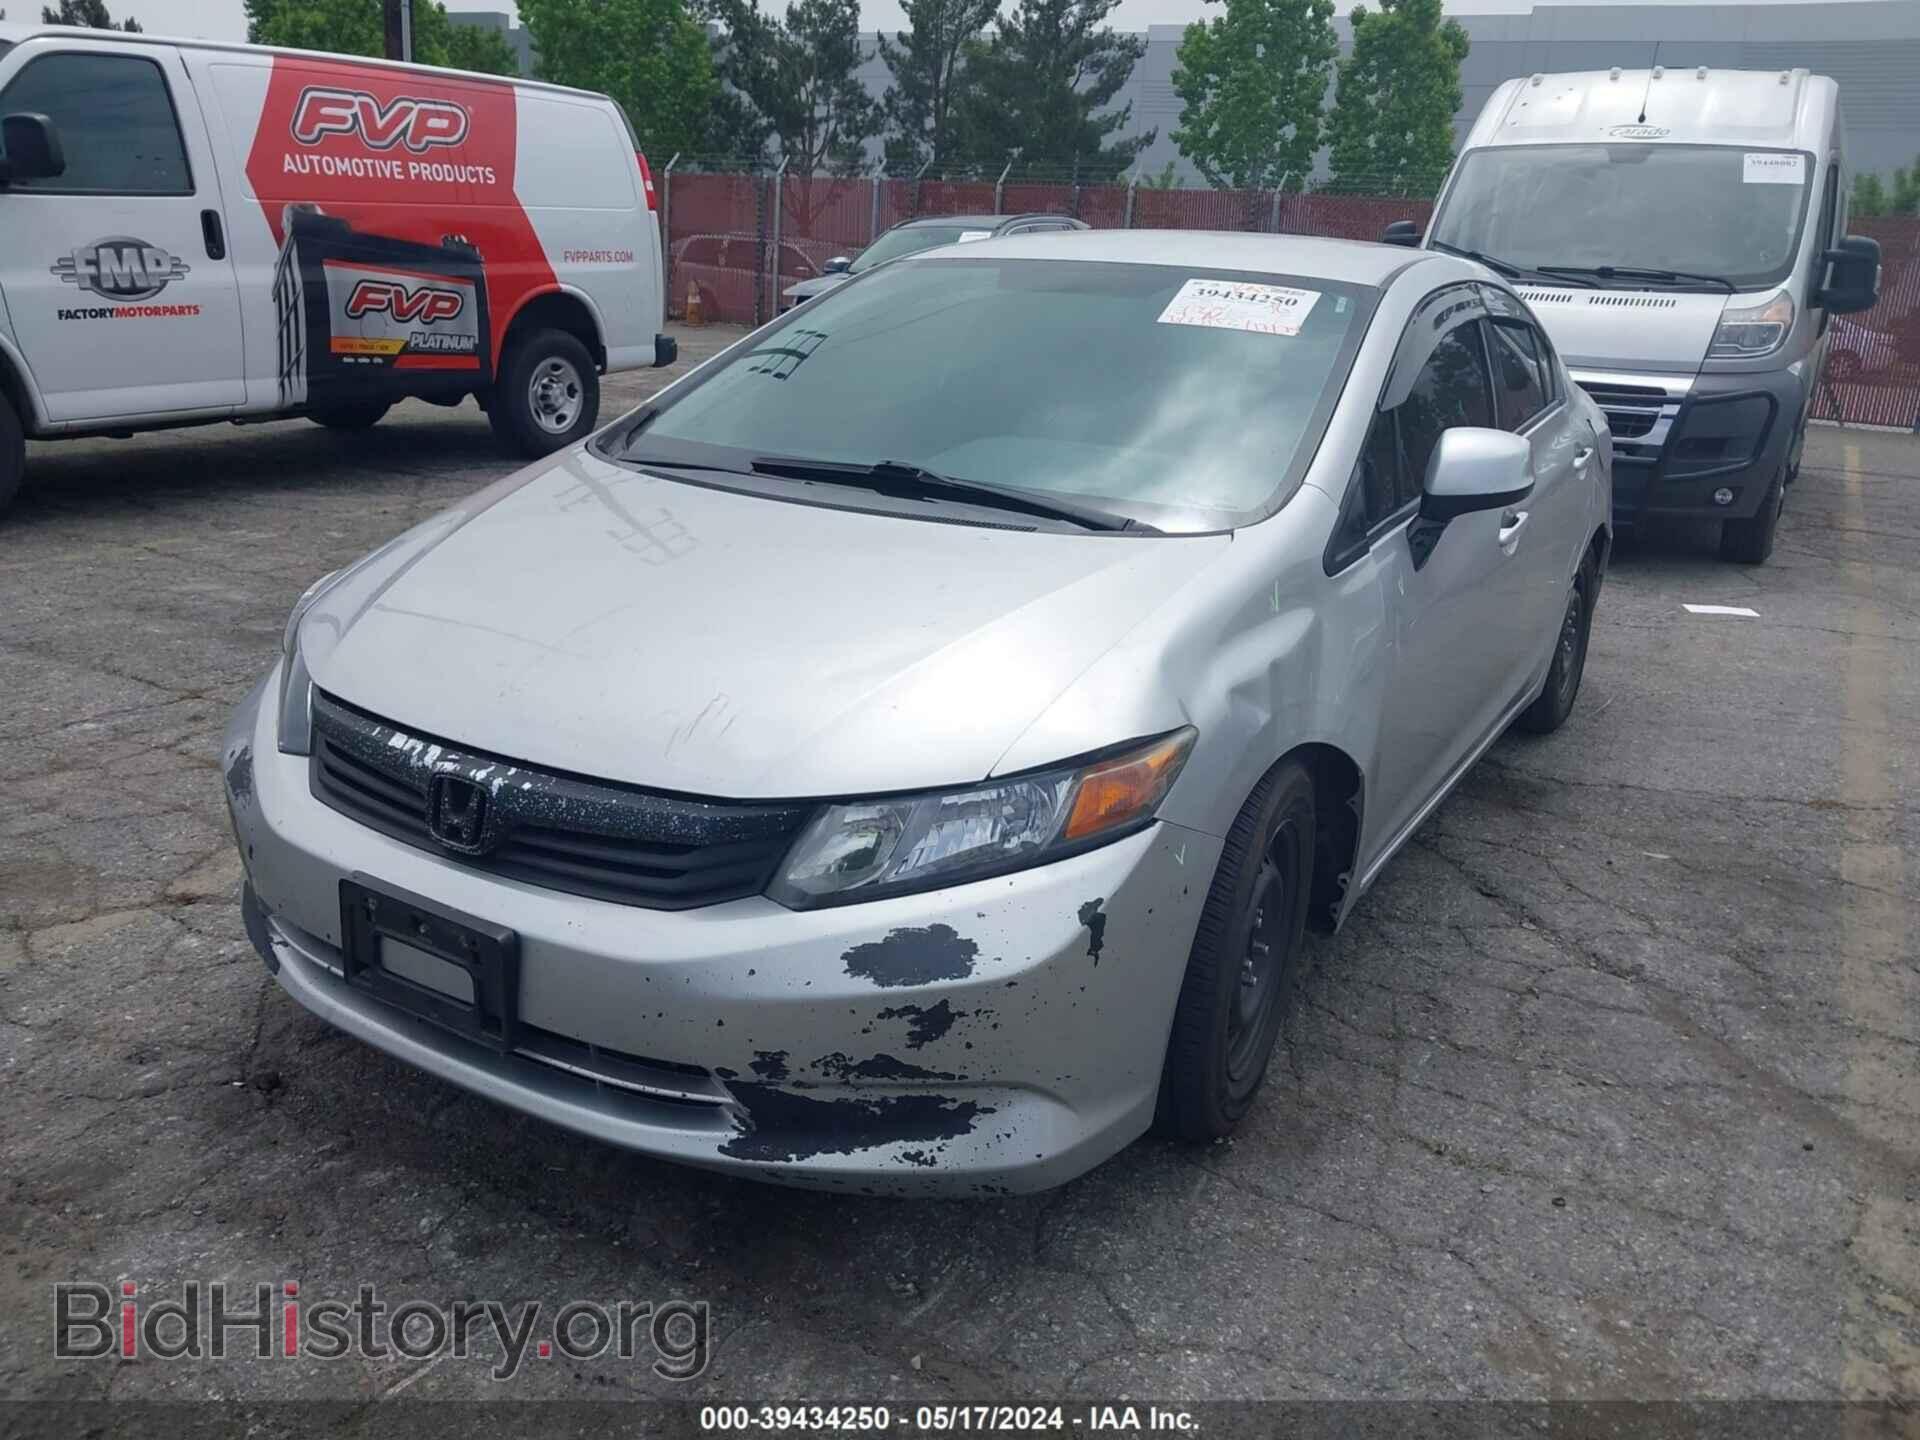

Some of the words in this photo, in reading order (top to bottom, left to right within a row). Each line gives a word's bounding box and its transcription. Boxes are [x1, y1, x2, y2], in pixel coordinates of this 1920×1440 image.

[290, 85, 471, 155] FVP
[282, 153, 405, 180] AUTOMOTIVE
[408, 162, 496, 185] PRODUCTS
[71, 246, 172, 290] FMP
[563, 250, 634, 263] FVPPARTS.COM
[345, 279, 464, 325] FVP
[1192, 287, 1299, 307] 39434250
[410, 332, 476, 351] PLATINUM
